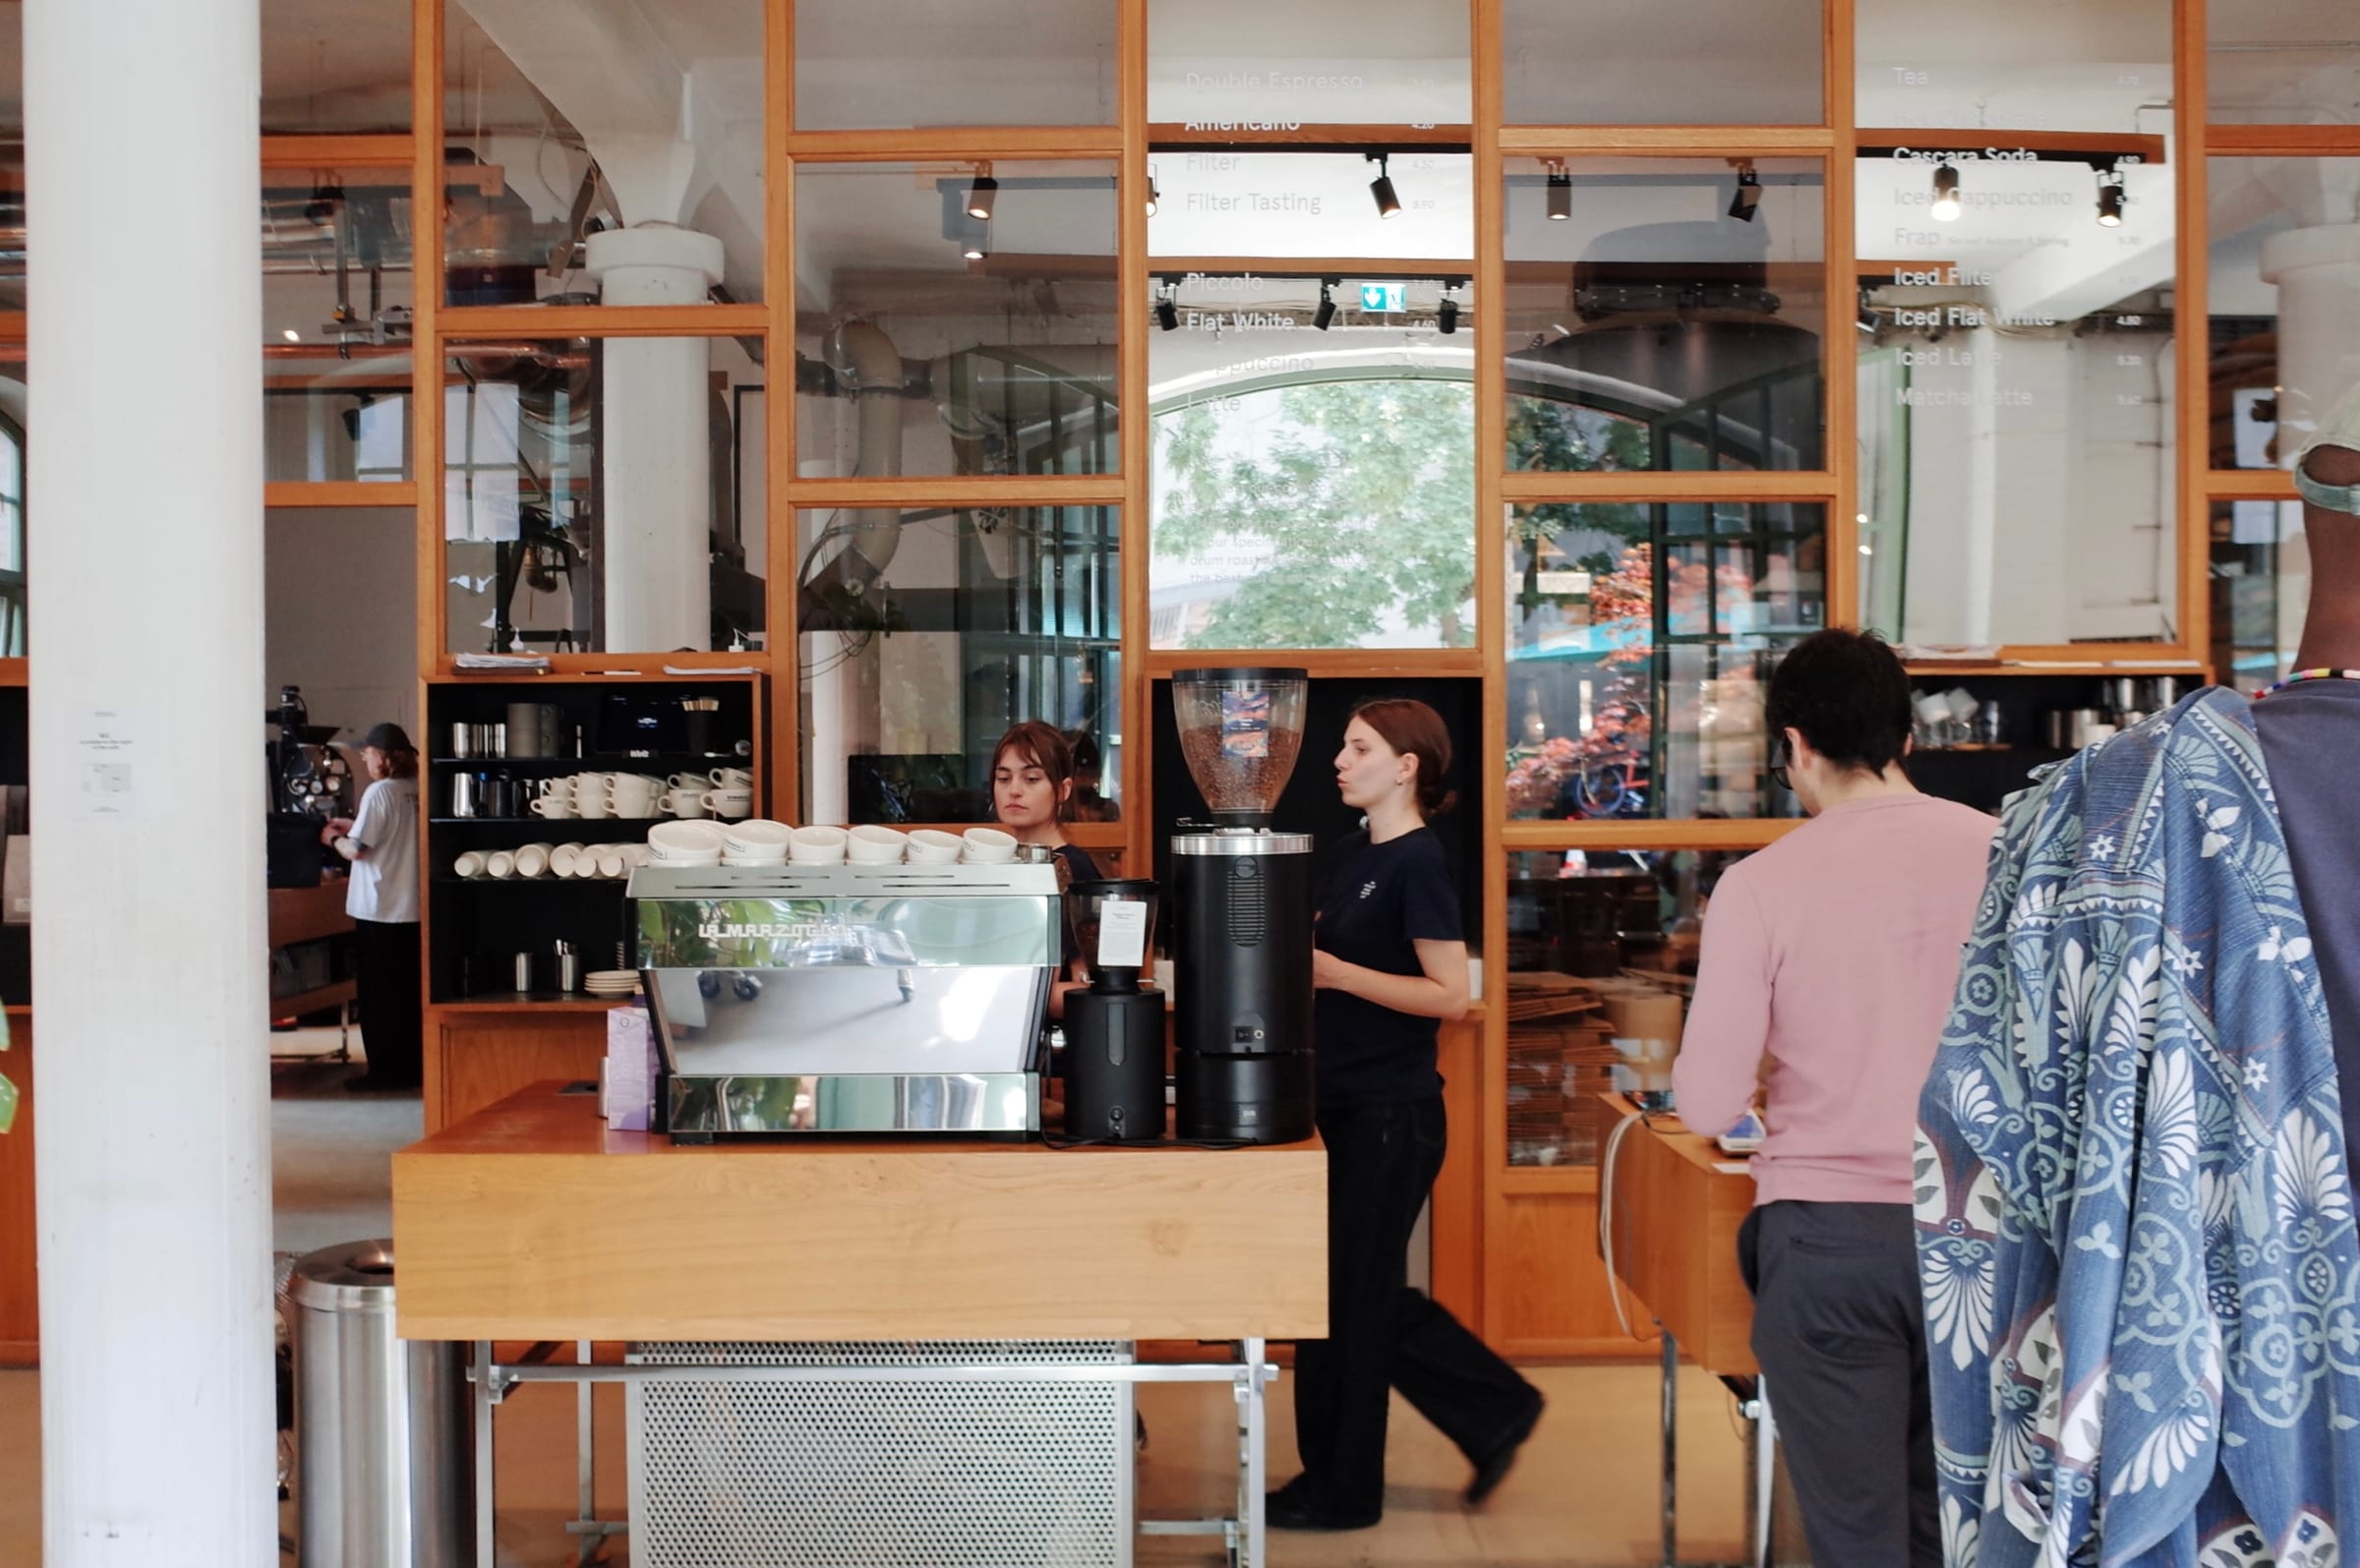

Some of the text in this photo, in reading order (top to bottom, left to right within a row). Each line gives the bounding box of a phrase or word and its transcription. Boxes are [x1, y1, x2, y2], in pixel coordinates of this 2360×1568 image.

[1186, 71, 1364, 93] Double Espresso
[1892, 66, 1929, 86] Tea
[1186, 153, 1241, 171] Filter
[1893, 146, 1978, 165] Cascara
[1984, 146, 2038, 165] Soda
[1186, 192, 1241, 211] Filter
[1248, 192, 1322, 215] Tasting
[1894, 187, 2073, 209] Iced Cappuccino
[1894, 227, 1941, 250] Frap
[1186, 271, 1265, 292] Piccolo
[1894, 266, 1941, 286] Iced
[1947, 266, 1996, 286] Filte
[1187, 313, 1225, 331] Flat
[1231, 313, 1295, 331] White
[1894, 307, 1941, 325] Iced
[1947, 307, 1986, 325] Flat
[1993, 307, 2056, 326] White
[1187, 355, 1315, 377] ppuccino
[1894, 347, 1942, 366] Iced
[1948, 347, 2003, 366] Lae
[1895, 387, 1973, 406] Matcha
[1980, 387, 2034, 406] atte
